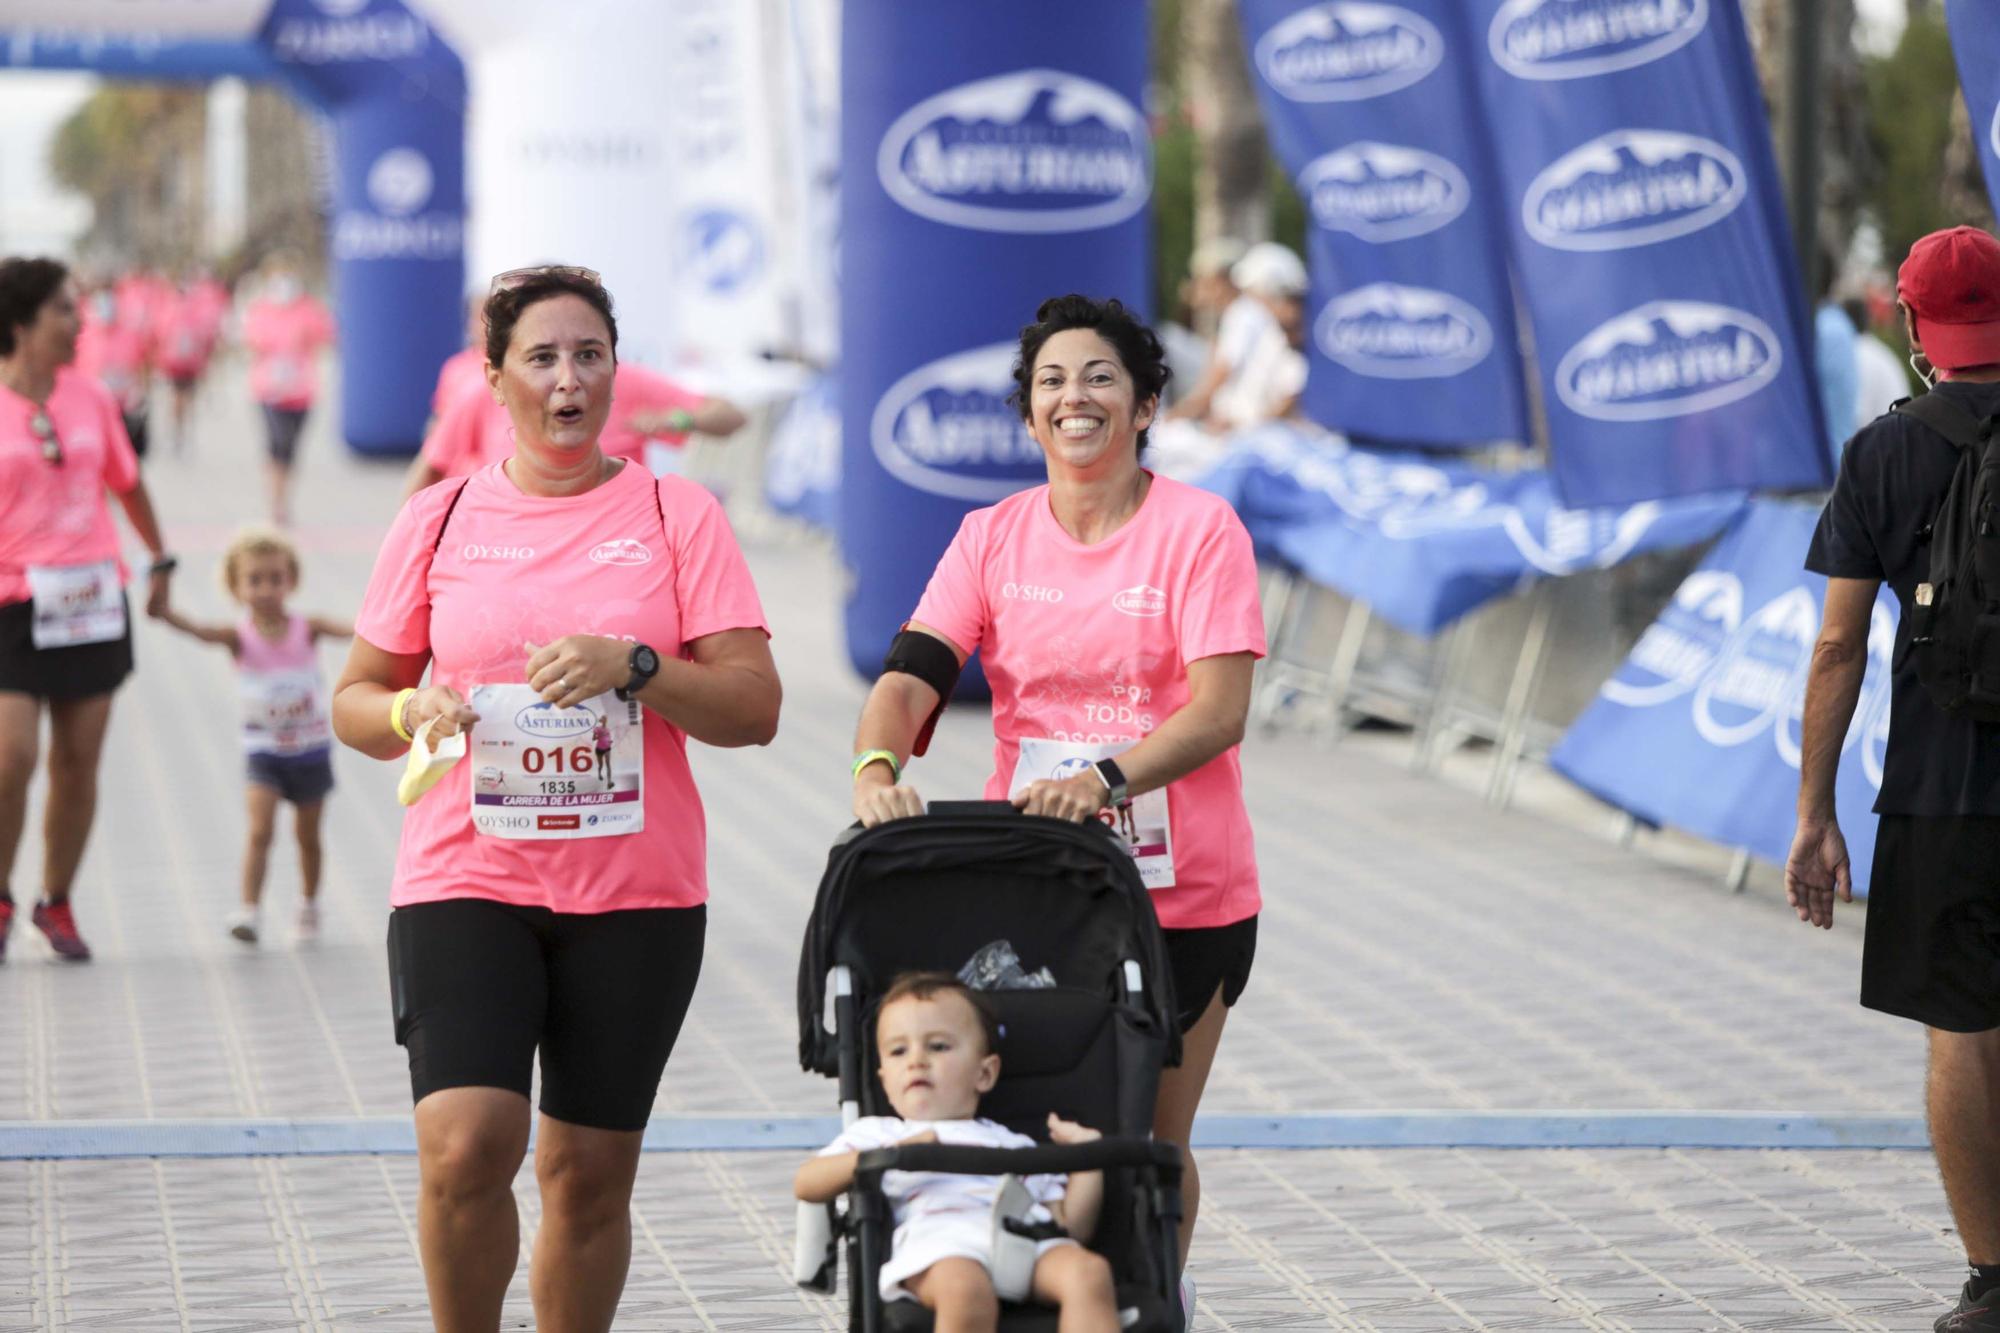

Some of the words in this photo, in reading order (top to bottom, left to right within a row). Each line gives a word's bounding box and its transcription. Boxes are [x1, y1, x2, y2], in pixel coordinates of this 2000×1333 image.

[464, 544, 535, 560] OYSHO
[1112, 685, 1152, 704] POR
[521, 713, 591, 728] ASTURIANA
[1084, 703, 1153, 732] TODS
[522, 746, 593, 774] 016
[540, 780, 576, 794] 1835
[502, 796, 548, 806] CARRERA
[551, 796, 563, 806] DE
[565, 796, 578, 806] LA
[580, 793, 614, 805] MUJER
[478, 815, 530, 829] OYSHO
